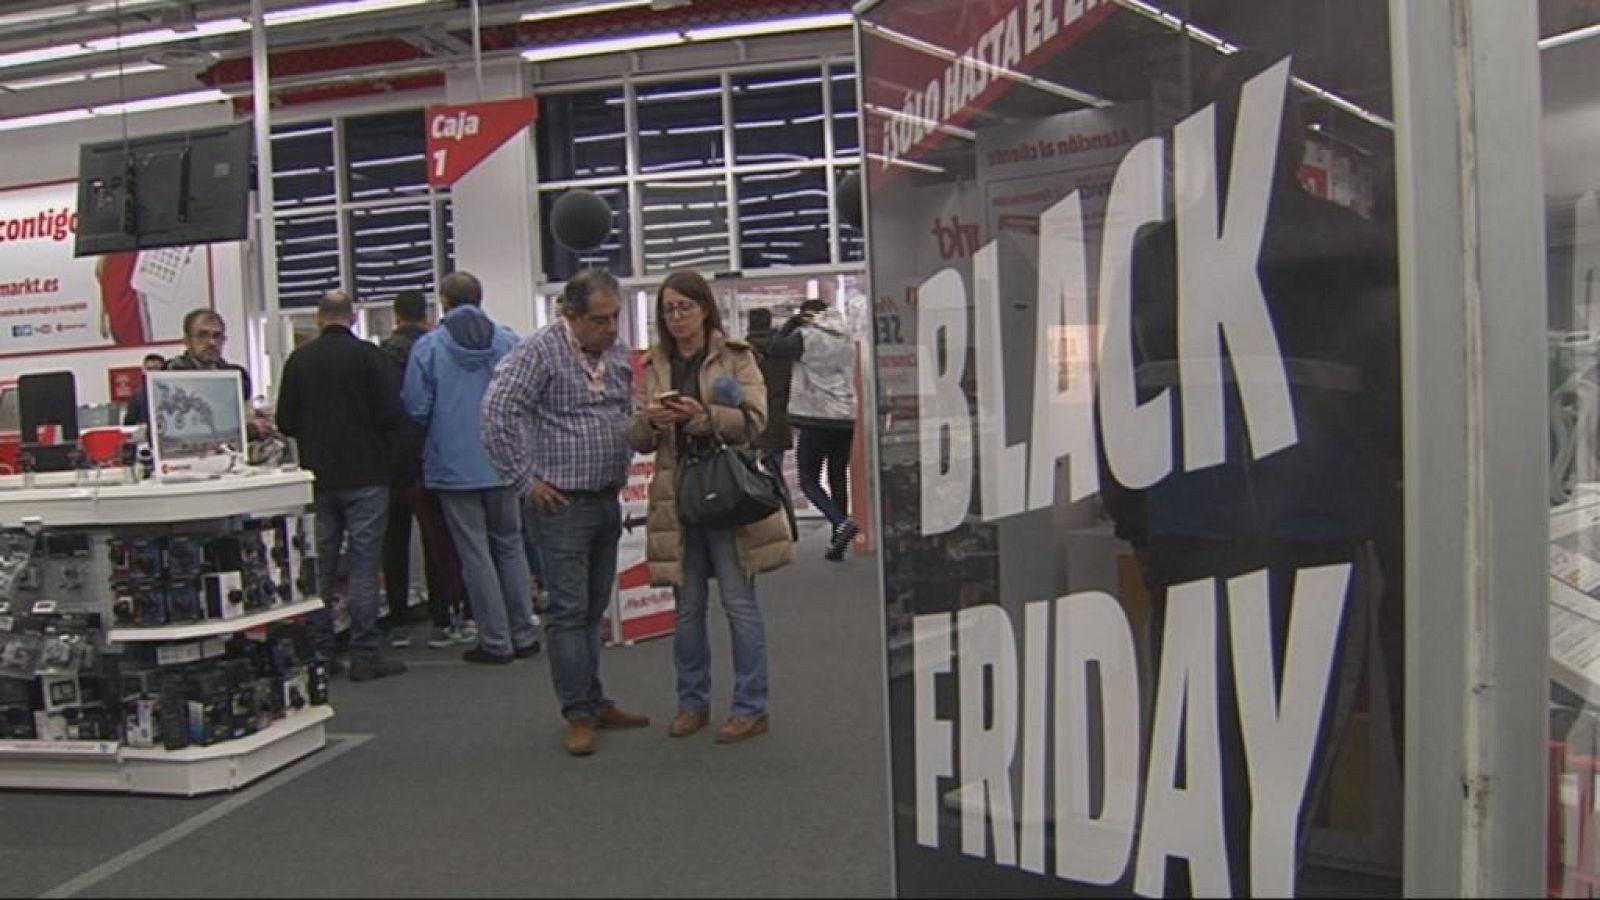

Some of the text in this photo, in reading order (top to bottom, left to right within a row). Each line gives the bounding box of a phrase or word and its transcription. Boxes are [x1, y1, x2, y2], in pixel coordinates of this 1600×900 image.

[943, 8, 1021, 120] HASTA
[1024, 0, 1059, 56] EL
[431, 110, 480, 141] Caja
[433, 149, 448, 177] 1
[918, 55, 1299, 536] BLACK
[912, 562, 1354, 899] FRIDAY
